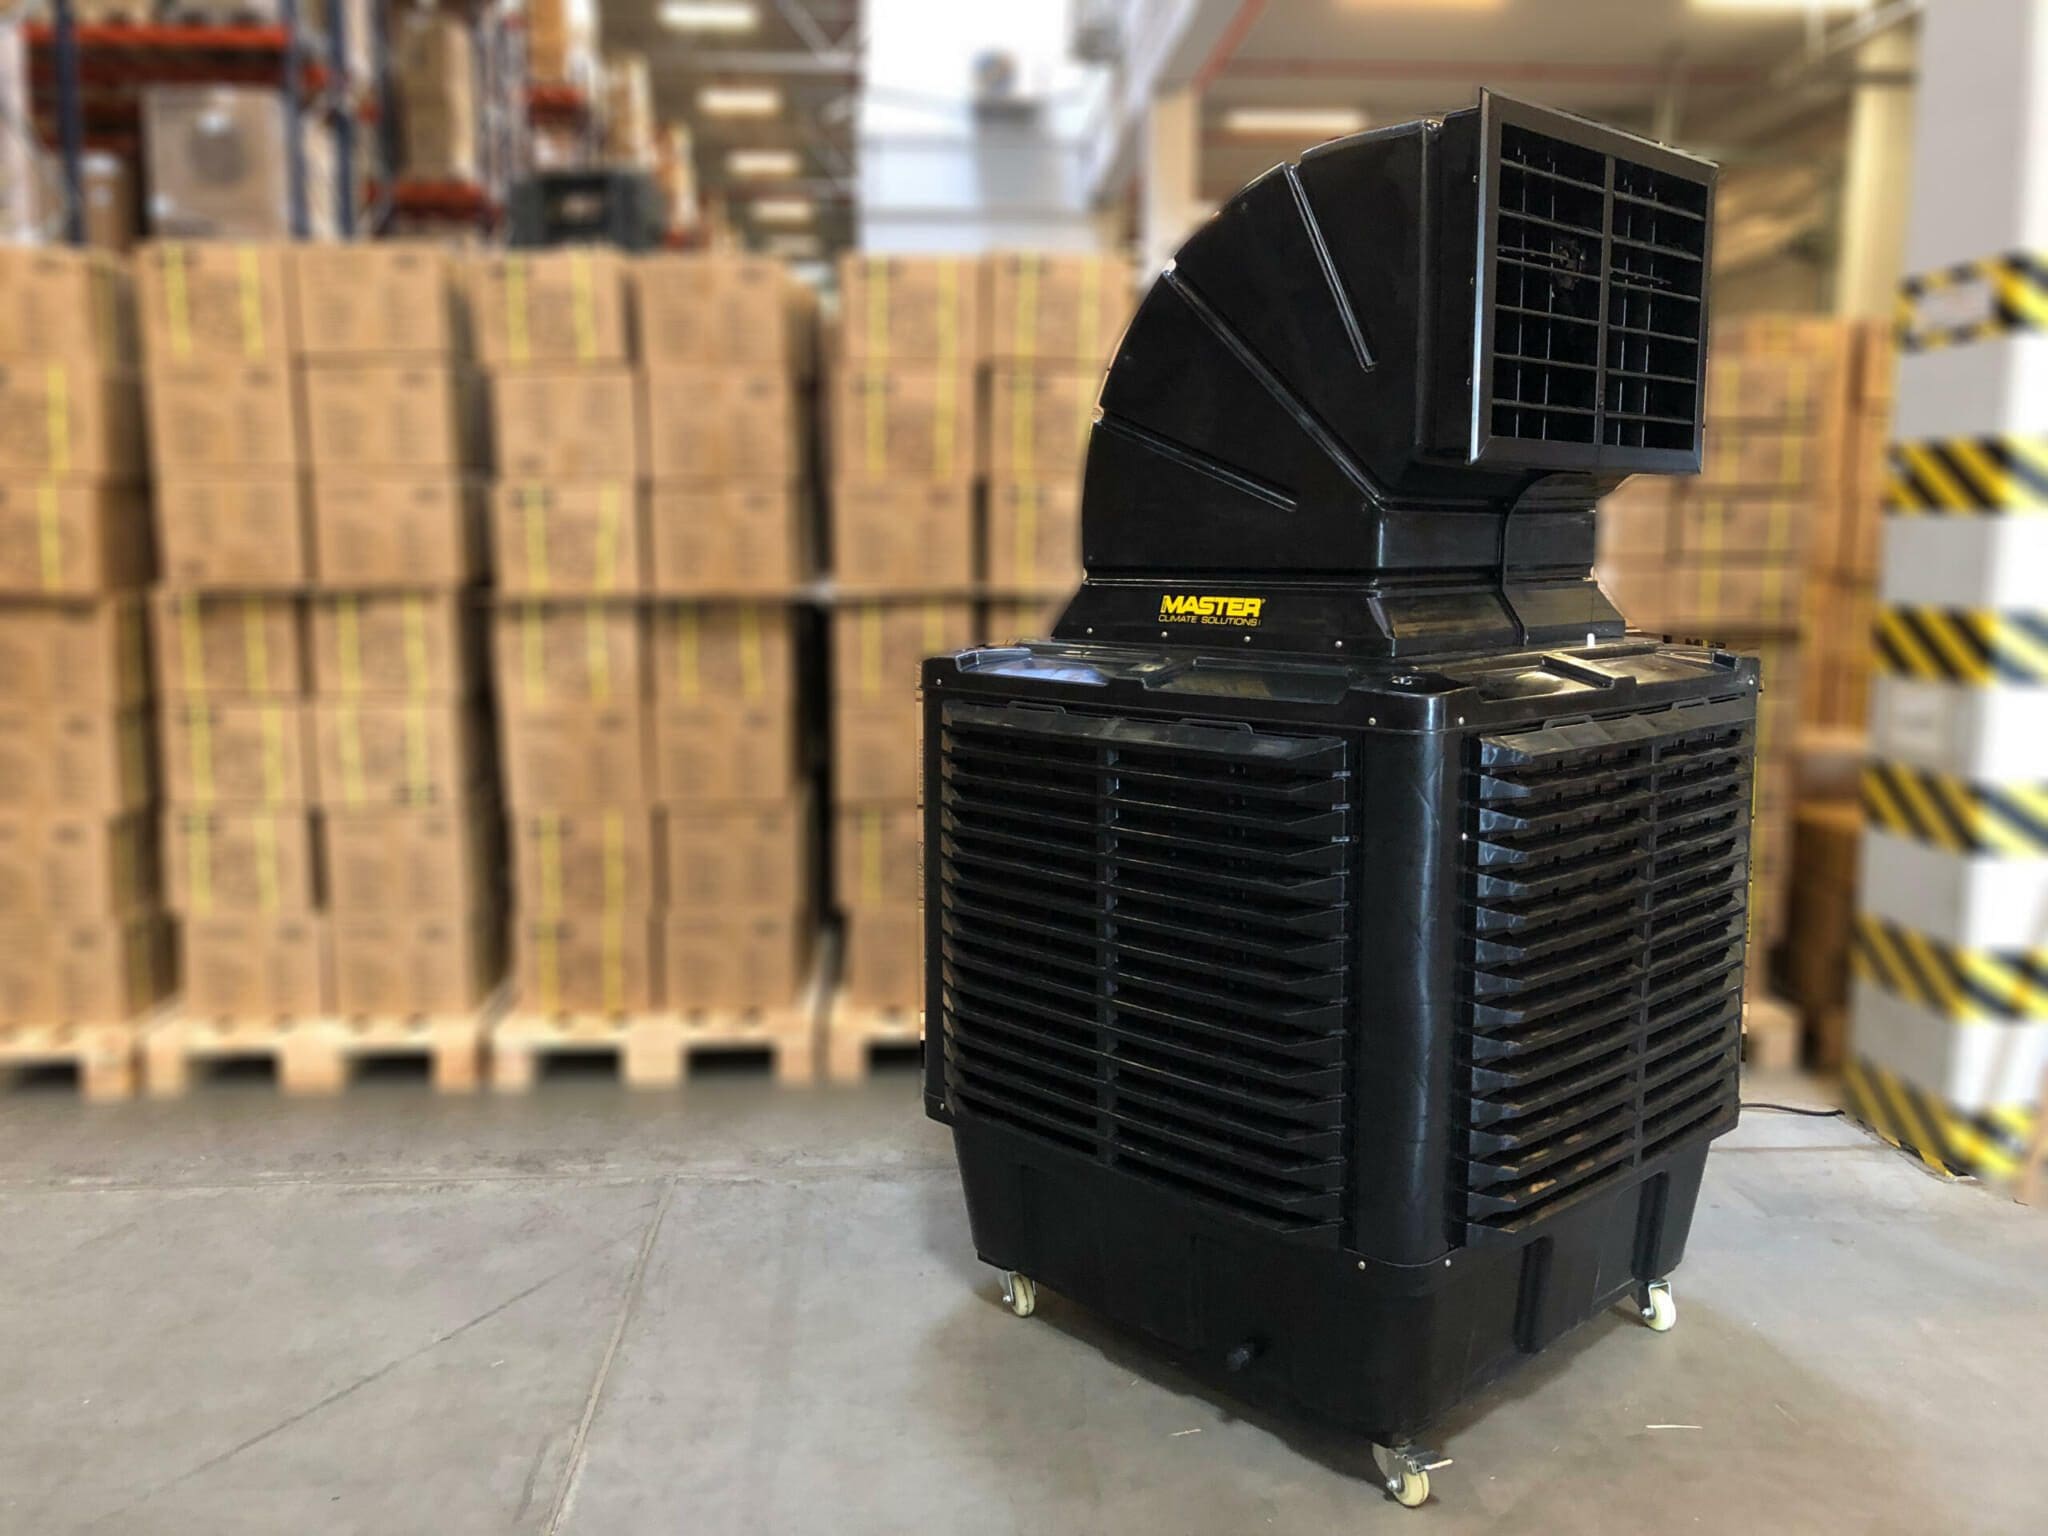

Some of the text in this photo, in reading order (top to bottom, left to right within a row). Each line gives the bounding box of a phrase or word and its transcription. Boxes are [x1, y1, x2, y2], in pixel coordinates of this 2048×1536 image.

[1160, 595, 1261, 617] MASTER
[1158, 614, 1258, 627] CLIMATE SOLUTIONS
